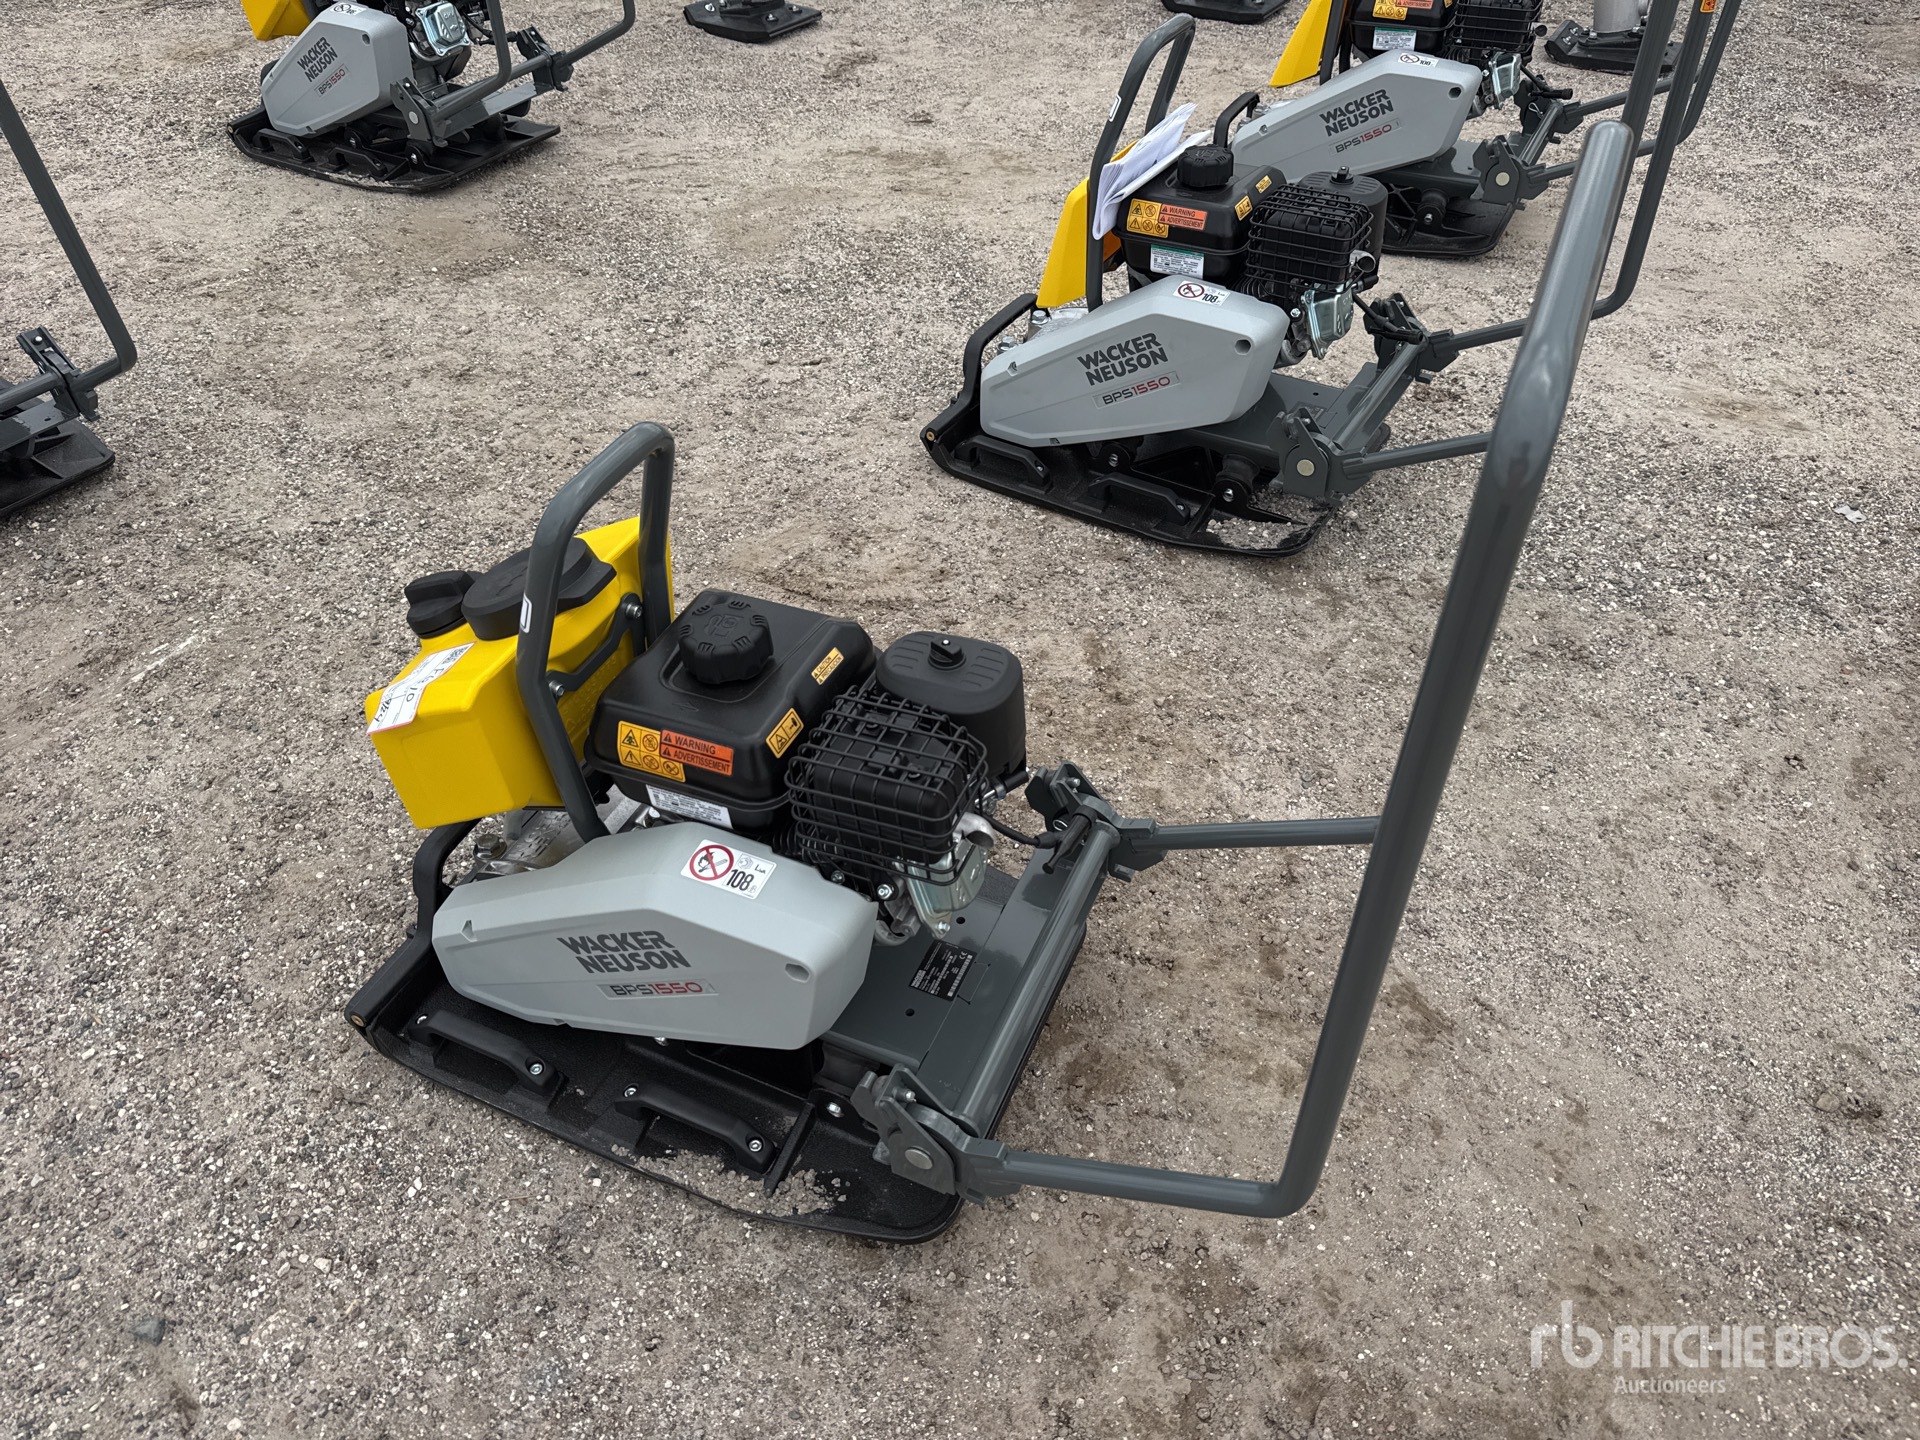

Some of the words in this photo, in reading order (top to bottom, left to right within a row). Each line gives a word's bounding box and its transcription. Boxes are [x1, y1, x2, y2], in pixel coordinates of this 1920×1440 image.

[297, 36, 331, 70] WACKER
[304, 46, 338, 82] NEUSON
[318, 68, 346, 95] BPS1550
[1319, 89, 1390, 124] WACKER
[1325, 100, 1394, 137] NEUSON
[1335, 124, 1393, 153] BPS1550
[1167, 216, 1204, 229] ADVERTISSEMENT
[1169, 206, 1196, 217] WARNING
[1201, 293, 1219, 303] 108
[1077, 332, 1161, 370] WACKER
[1085, 347, 1169, 387] NEUSON
[1102, 376, 1171, 405] BPS1550
[674, 735, 716, 755] WARNING
[673, 749, 730, 774] ADVERTISSEMENT
[726, 868, 755, 892] 108
[556, 930, 676, 955] WACKER
[575, 949, 692, 974] NEUSON
[609, 982, 704, 996] BPS1550
